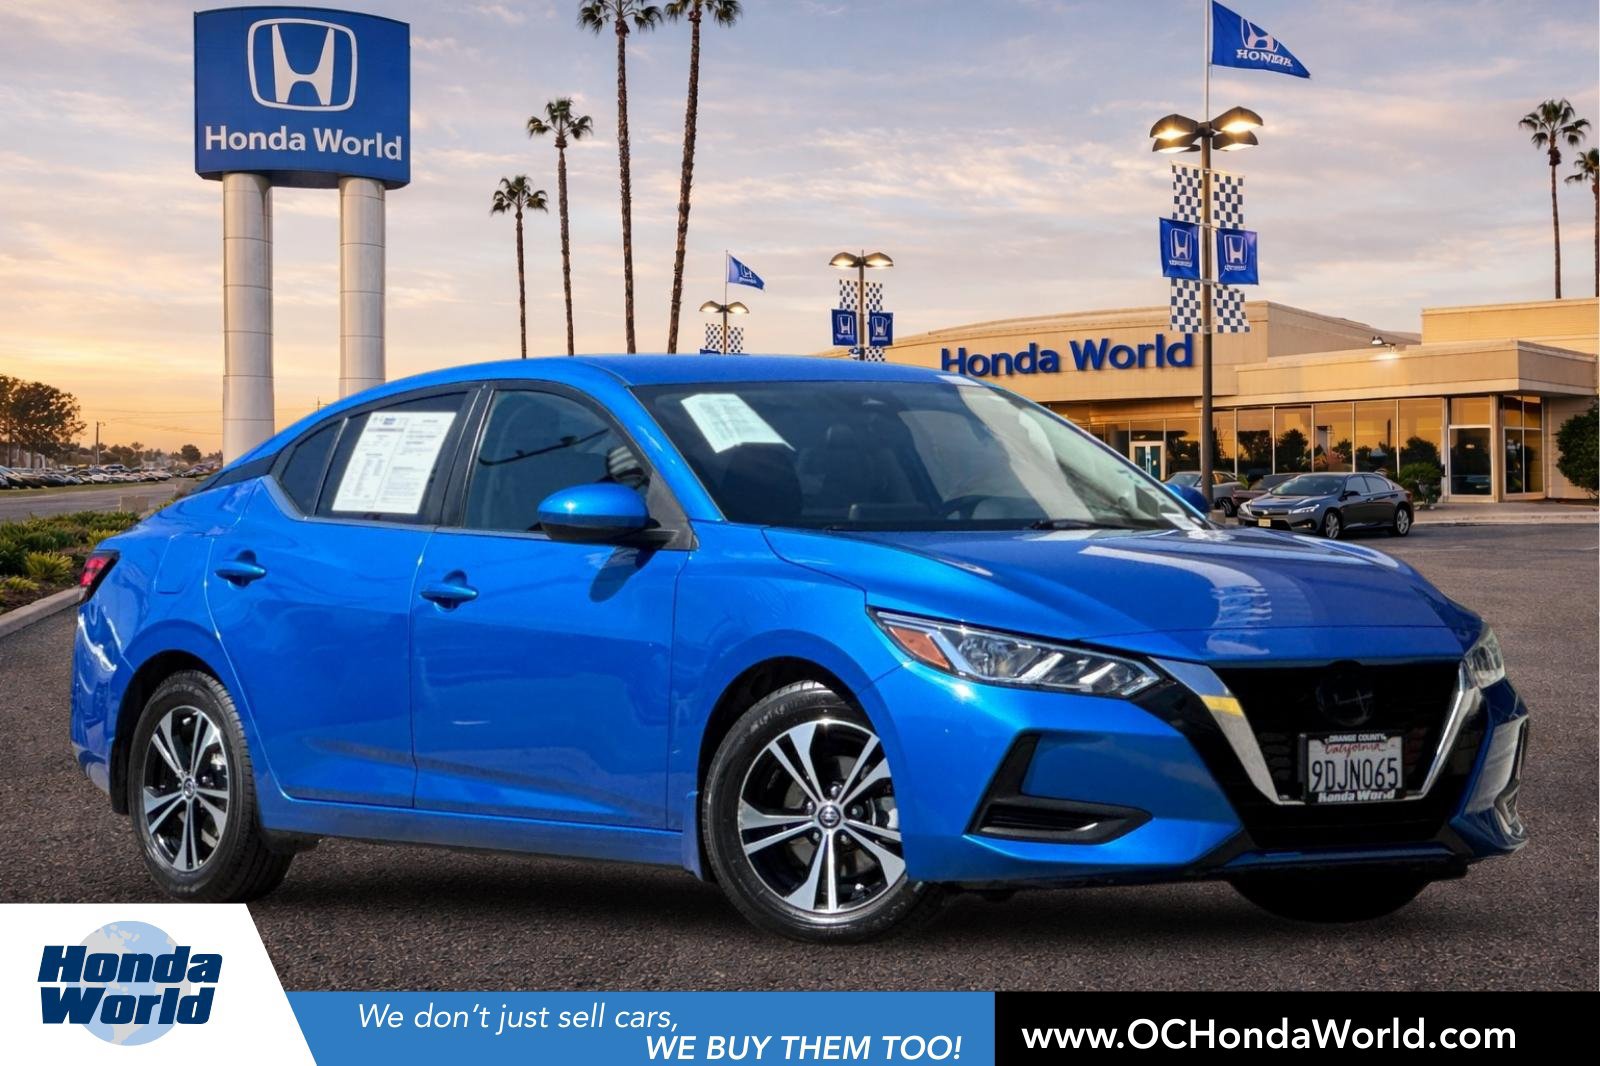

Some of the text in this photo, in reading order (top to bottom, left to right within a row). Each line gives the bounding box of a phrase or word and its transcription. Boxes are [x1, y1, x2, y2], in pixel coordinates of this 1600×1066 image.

[205, 125, 402, 161] Honda World
[941, 332, 1194, 377] Honda World
[1358, 733, 1385, 742] COUNTY
[1312, 758, 1397, 791] 9DJN065
[1317, 791, 1355, 802] Honda
